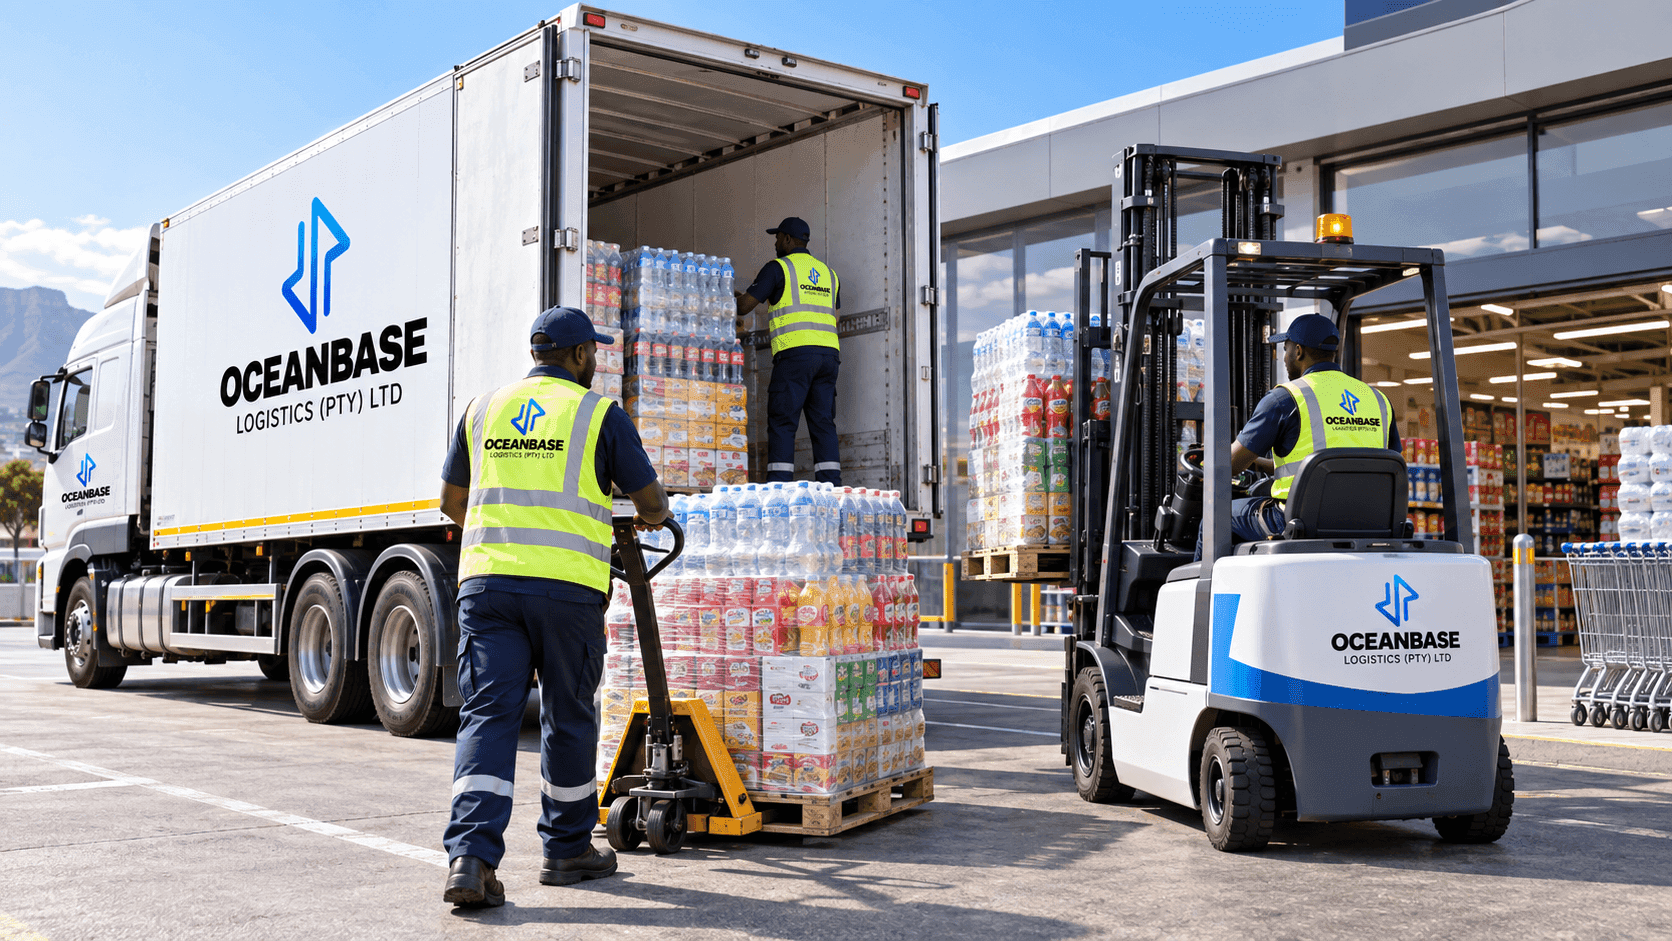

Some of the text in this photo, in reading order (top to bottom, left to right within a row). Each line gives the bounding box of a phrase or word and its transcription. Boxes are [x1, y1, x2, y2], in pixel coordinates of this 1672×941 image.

[220, 317, 428, 407] OCEANBASE
[236, 382, 403, 434] LOGISTICS (PTY) LTD
[1325, 416, 1381, 427] OCEANBASE
[484, 438, 564, 451] OCEANBASE
[489, 451, 522, 459] LOGISTICS
[61, 485, 111, 503] OCEANBASE
[1331, 631, 1460, 651] OCEANBASE
[1343, 653, 1452, 665] LOGISTICS (PTY) LTD
